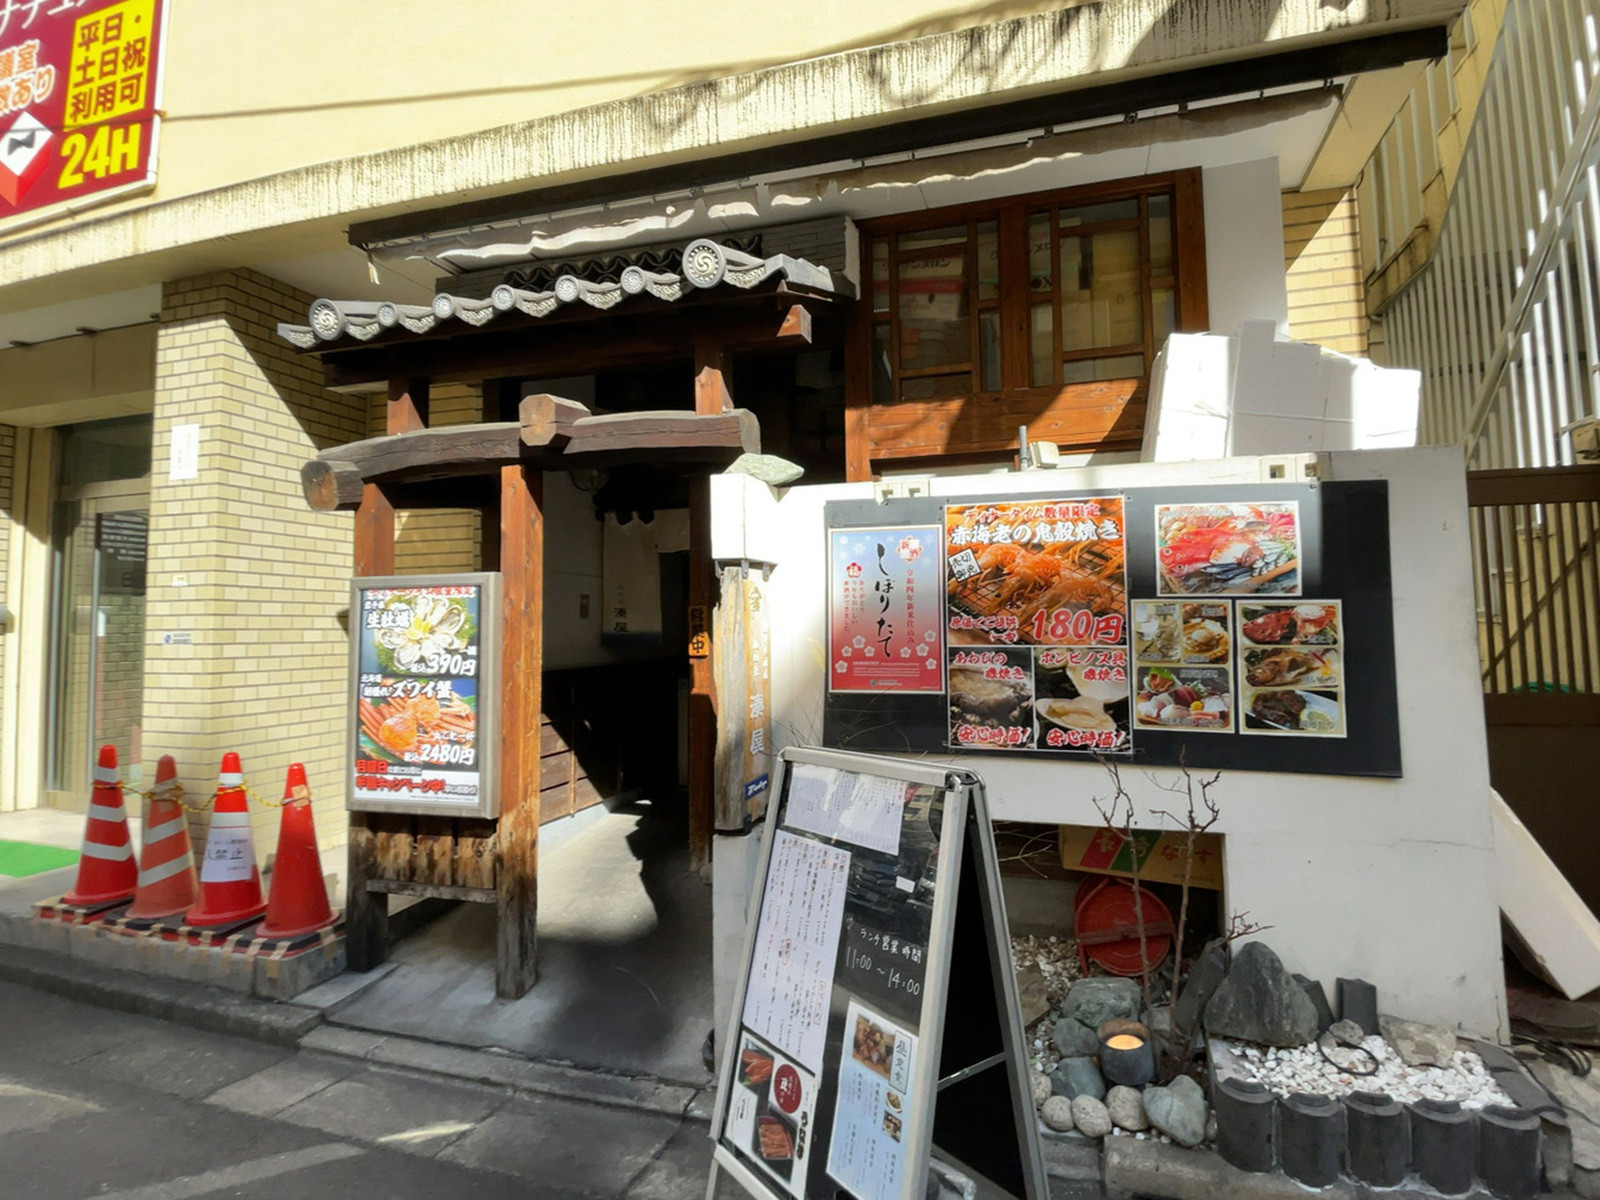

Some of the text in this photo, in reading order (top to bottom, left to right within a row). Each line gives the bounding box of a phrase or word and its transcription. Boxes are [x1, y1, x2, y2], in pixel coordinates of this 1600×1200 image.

[73, 36, 146, 88] 土日祝
[70, 72, 143, 122] 利用可
[57, 123, 141, 189] 24H
[963, 503, 1101, 523] ディナータイム数量限定
[951, 519, 1122, 545] 赤海老の鬼殻焼き
[874, 542, 896, 658] しぼりたて
[1032, 608, 1124, 644] 180円
[955, 651, 1008, 665] あわびの
[984, 666, 1026, 681] 磯焼き
[1083, 667, 1127, 683] 磯焼き
[958, 725, 1032, 745] 安心時価!
[1046, 727, 1127, 748] 安心時価!
